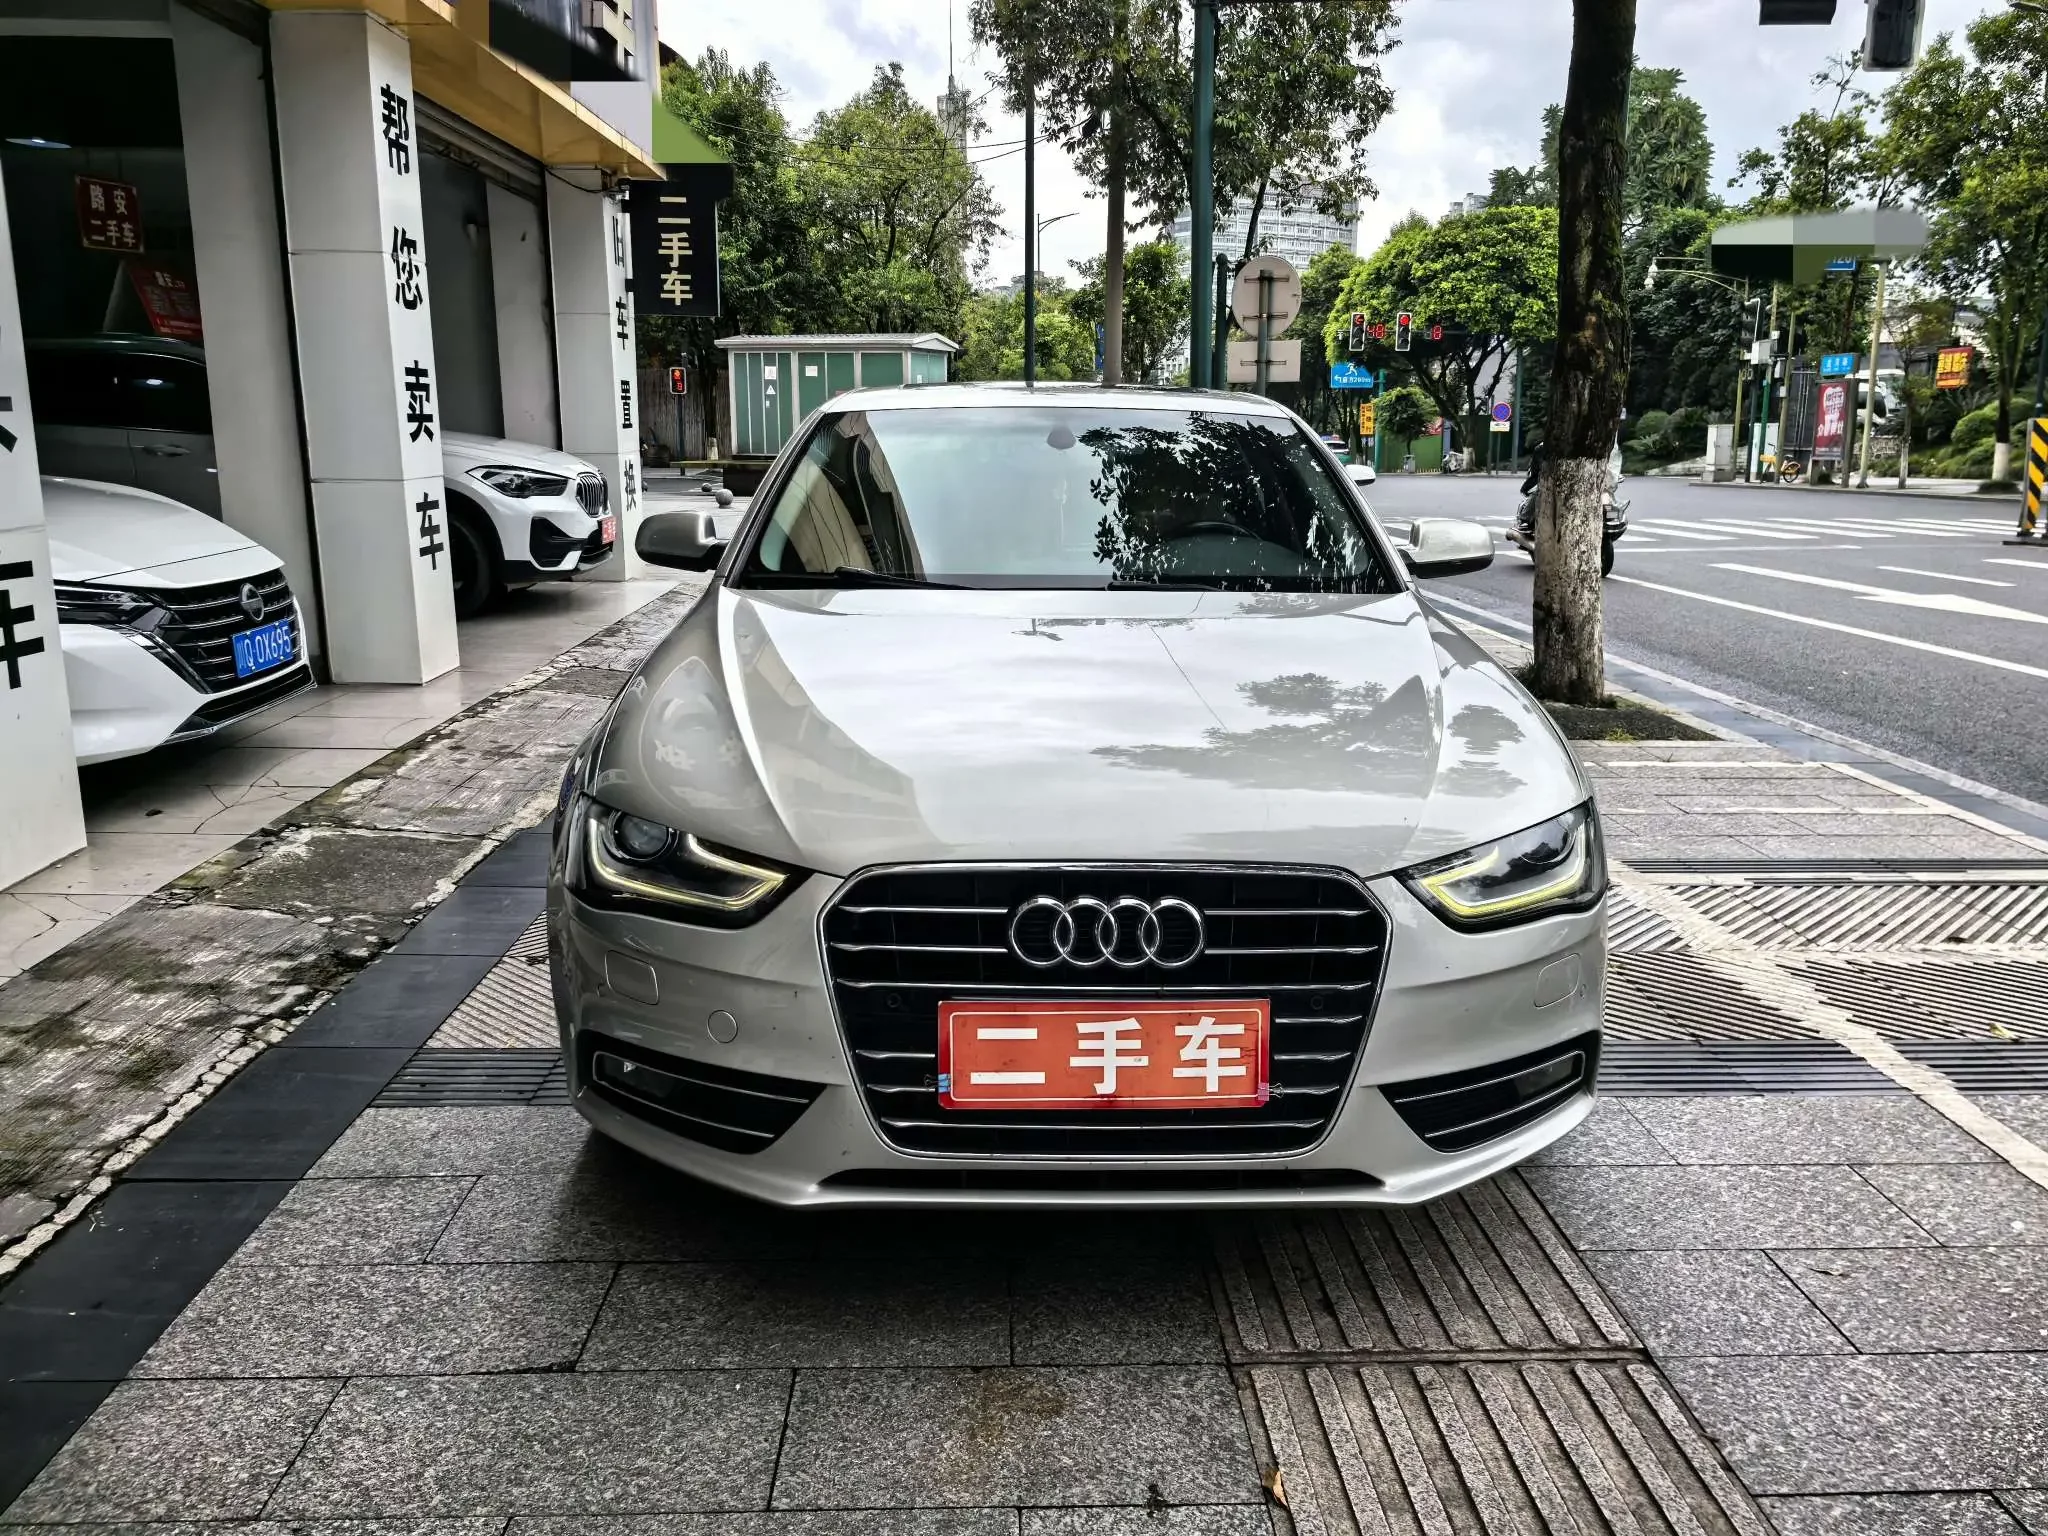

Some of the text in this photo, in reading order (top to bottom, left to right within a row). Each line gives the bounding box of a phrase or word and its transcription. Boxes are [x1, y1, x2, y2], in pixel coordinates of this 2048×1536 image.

[91, 219, 137, 248] 二手车
[658, 196, 693, 306] 二手车
[381, 83, 444, 571] 帮您卖车
[970, 1016, 1247, 1095] 二手车
